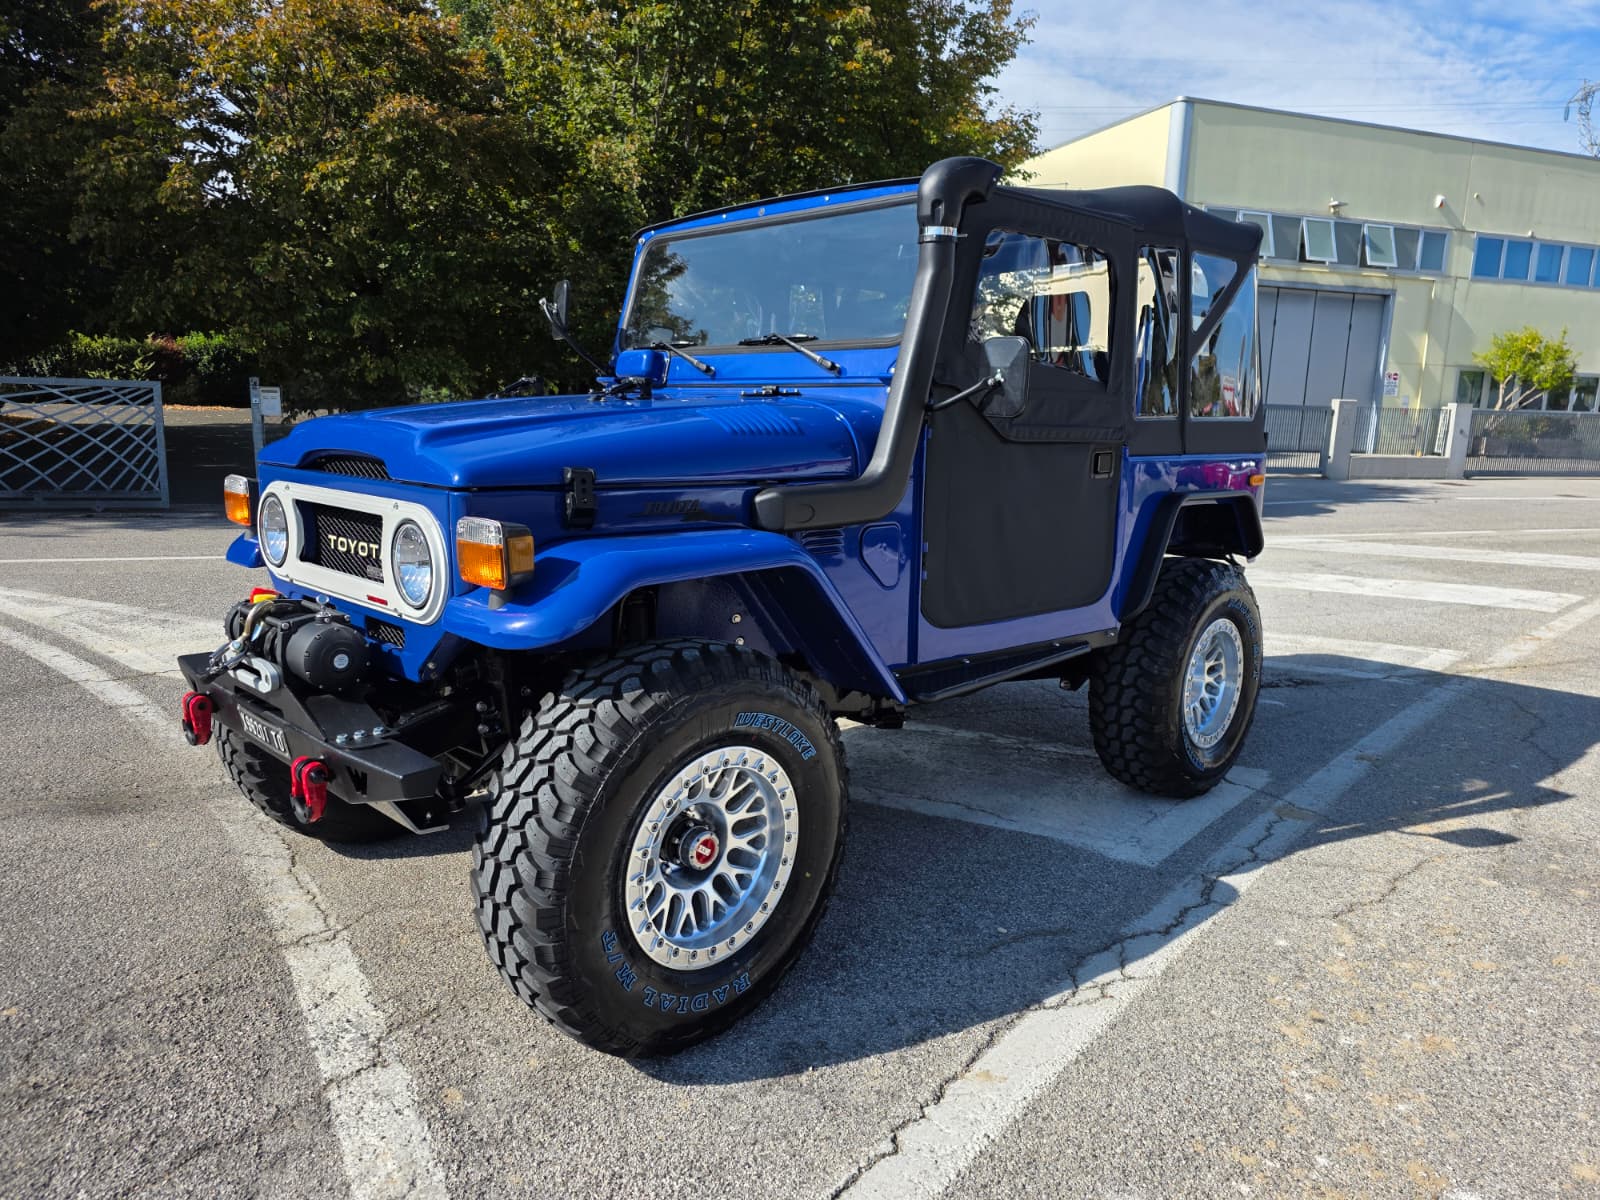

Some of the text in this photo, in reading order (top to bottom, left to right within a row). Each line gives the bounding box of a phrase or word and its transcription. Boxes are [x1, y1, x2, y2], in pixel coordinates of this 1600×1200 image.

[328, 534, 382, 560] TOYOT
[735, 712, 817, 761] WESTLAKE
[601, 930, 751, 1014] RADIAL M/T
